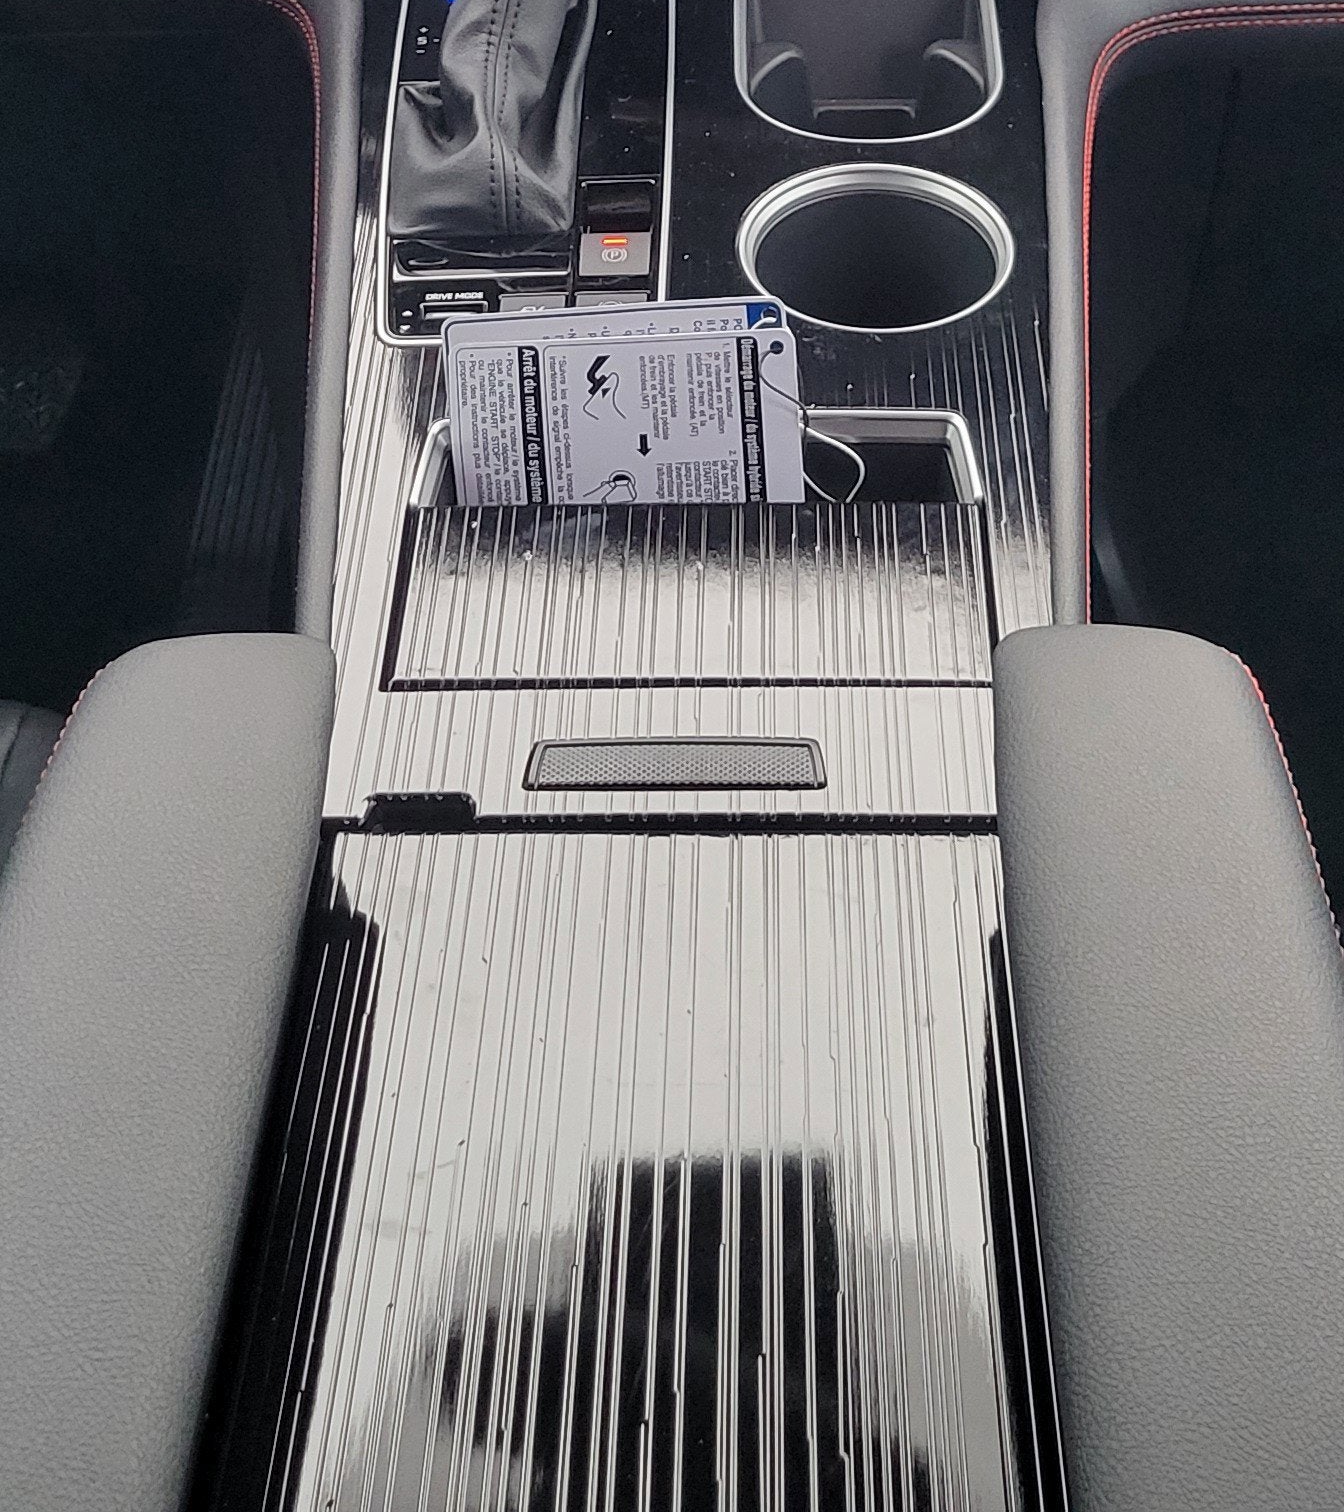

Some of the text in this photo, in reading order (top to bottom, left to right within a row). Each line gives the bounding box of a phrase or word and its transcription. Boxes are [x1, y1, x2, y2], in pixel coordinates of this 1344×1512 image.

[425, 291, 484, 301] DRIVE MODE
[522, 348, 536, 378] Arrêt
[524, 378, 537, 394] du
[489, 401, 498, 430] START
[525, 396, 539, 435] moteur
[529, 442, 542, 457] du
[526, 459, 545, 503] système
[702, 460, 712, 486] START
